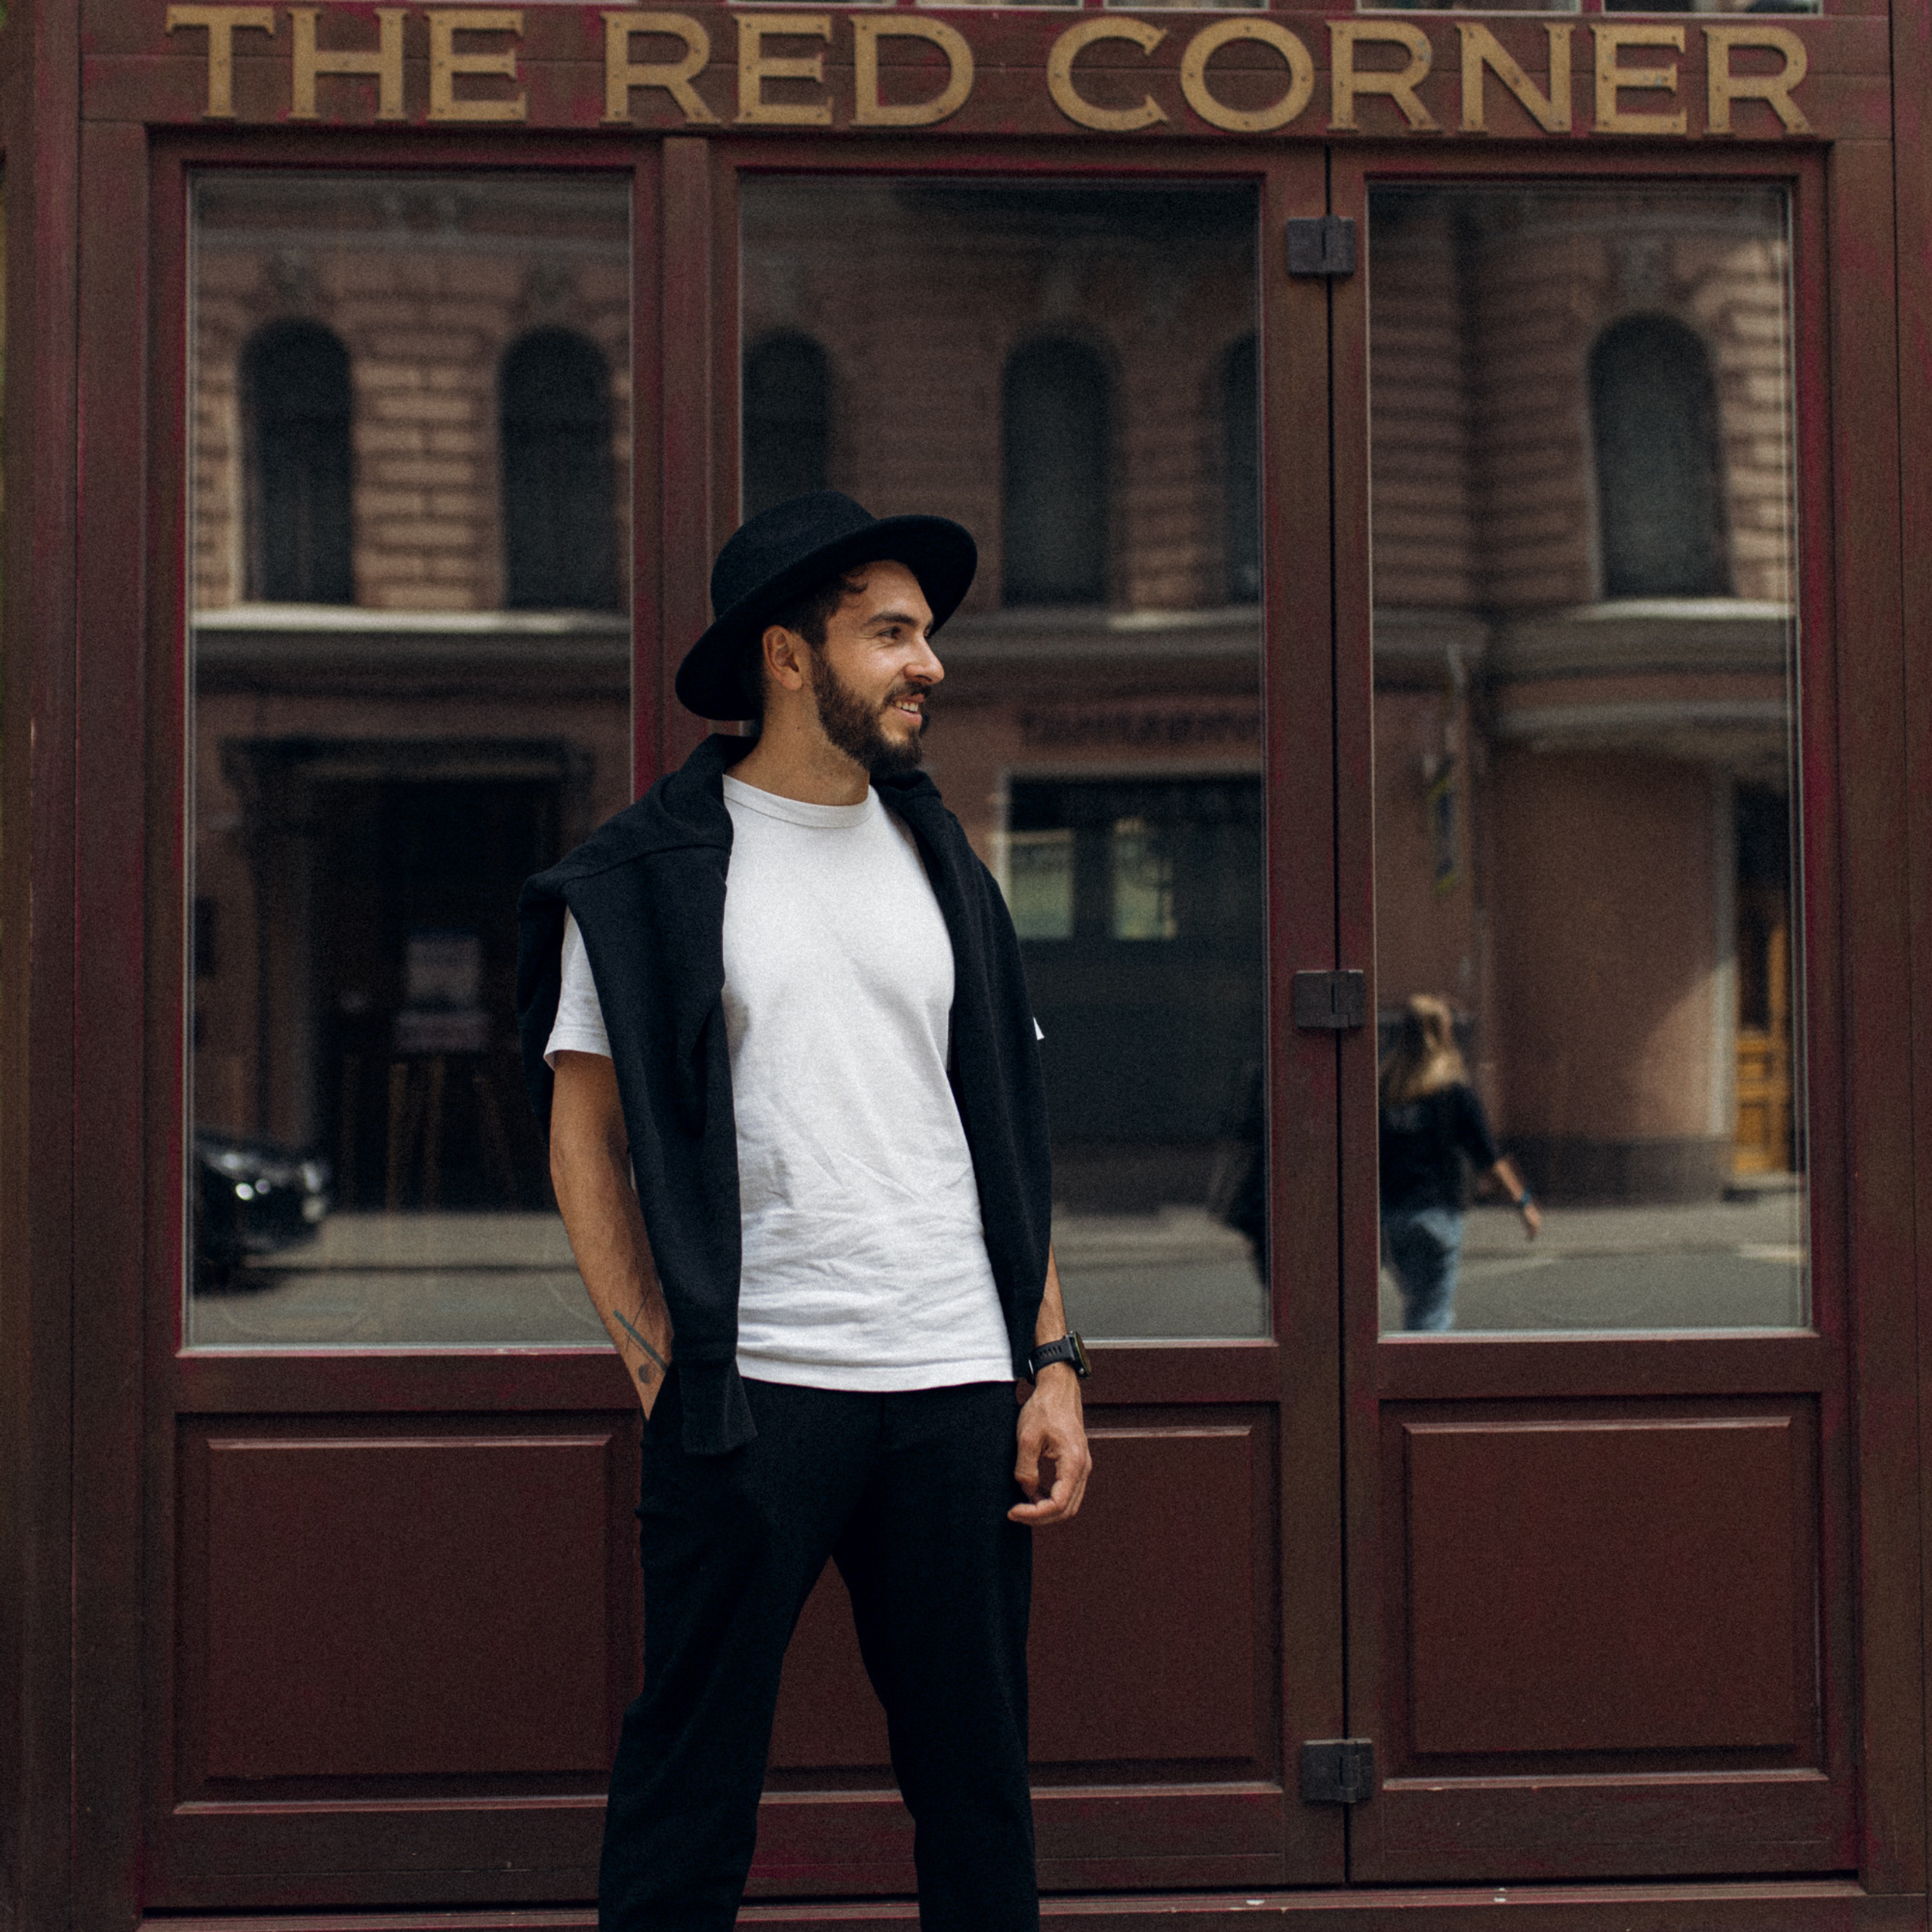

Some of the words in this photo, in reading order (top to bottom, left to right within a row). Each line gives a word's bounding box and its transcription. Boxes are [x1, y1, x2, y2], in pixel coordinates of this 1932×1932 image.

[165, 5, 528, 123] THE
[601, 11, 974, 128] RED
[1047, 17, 1814, 137] CORNER
